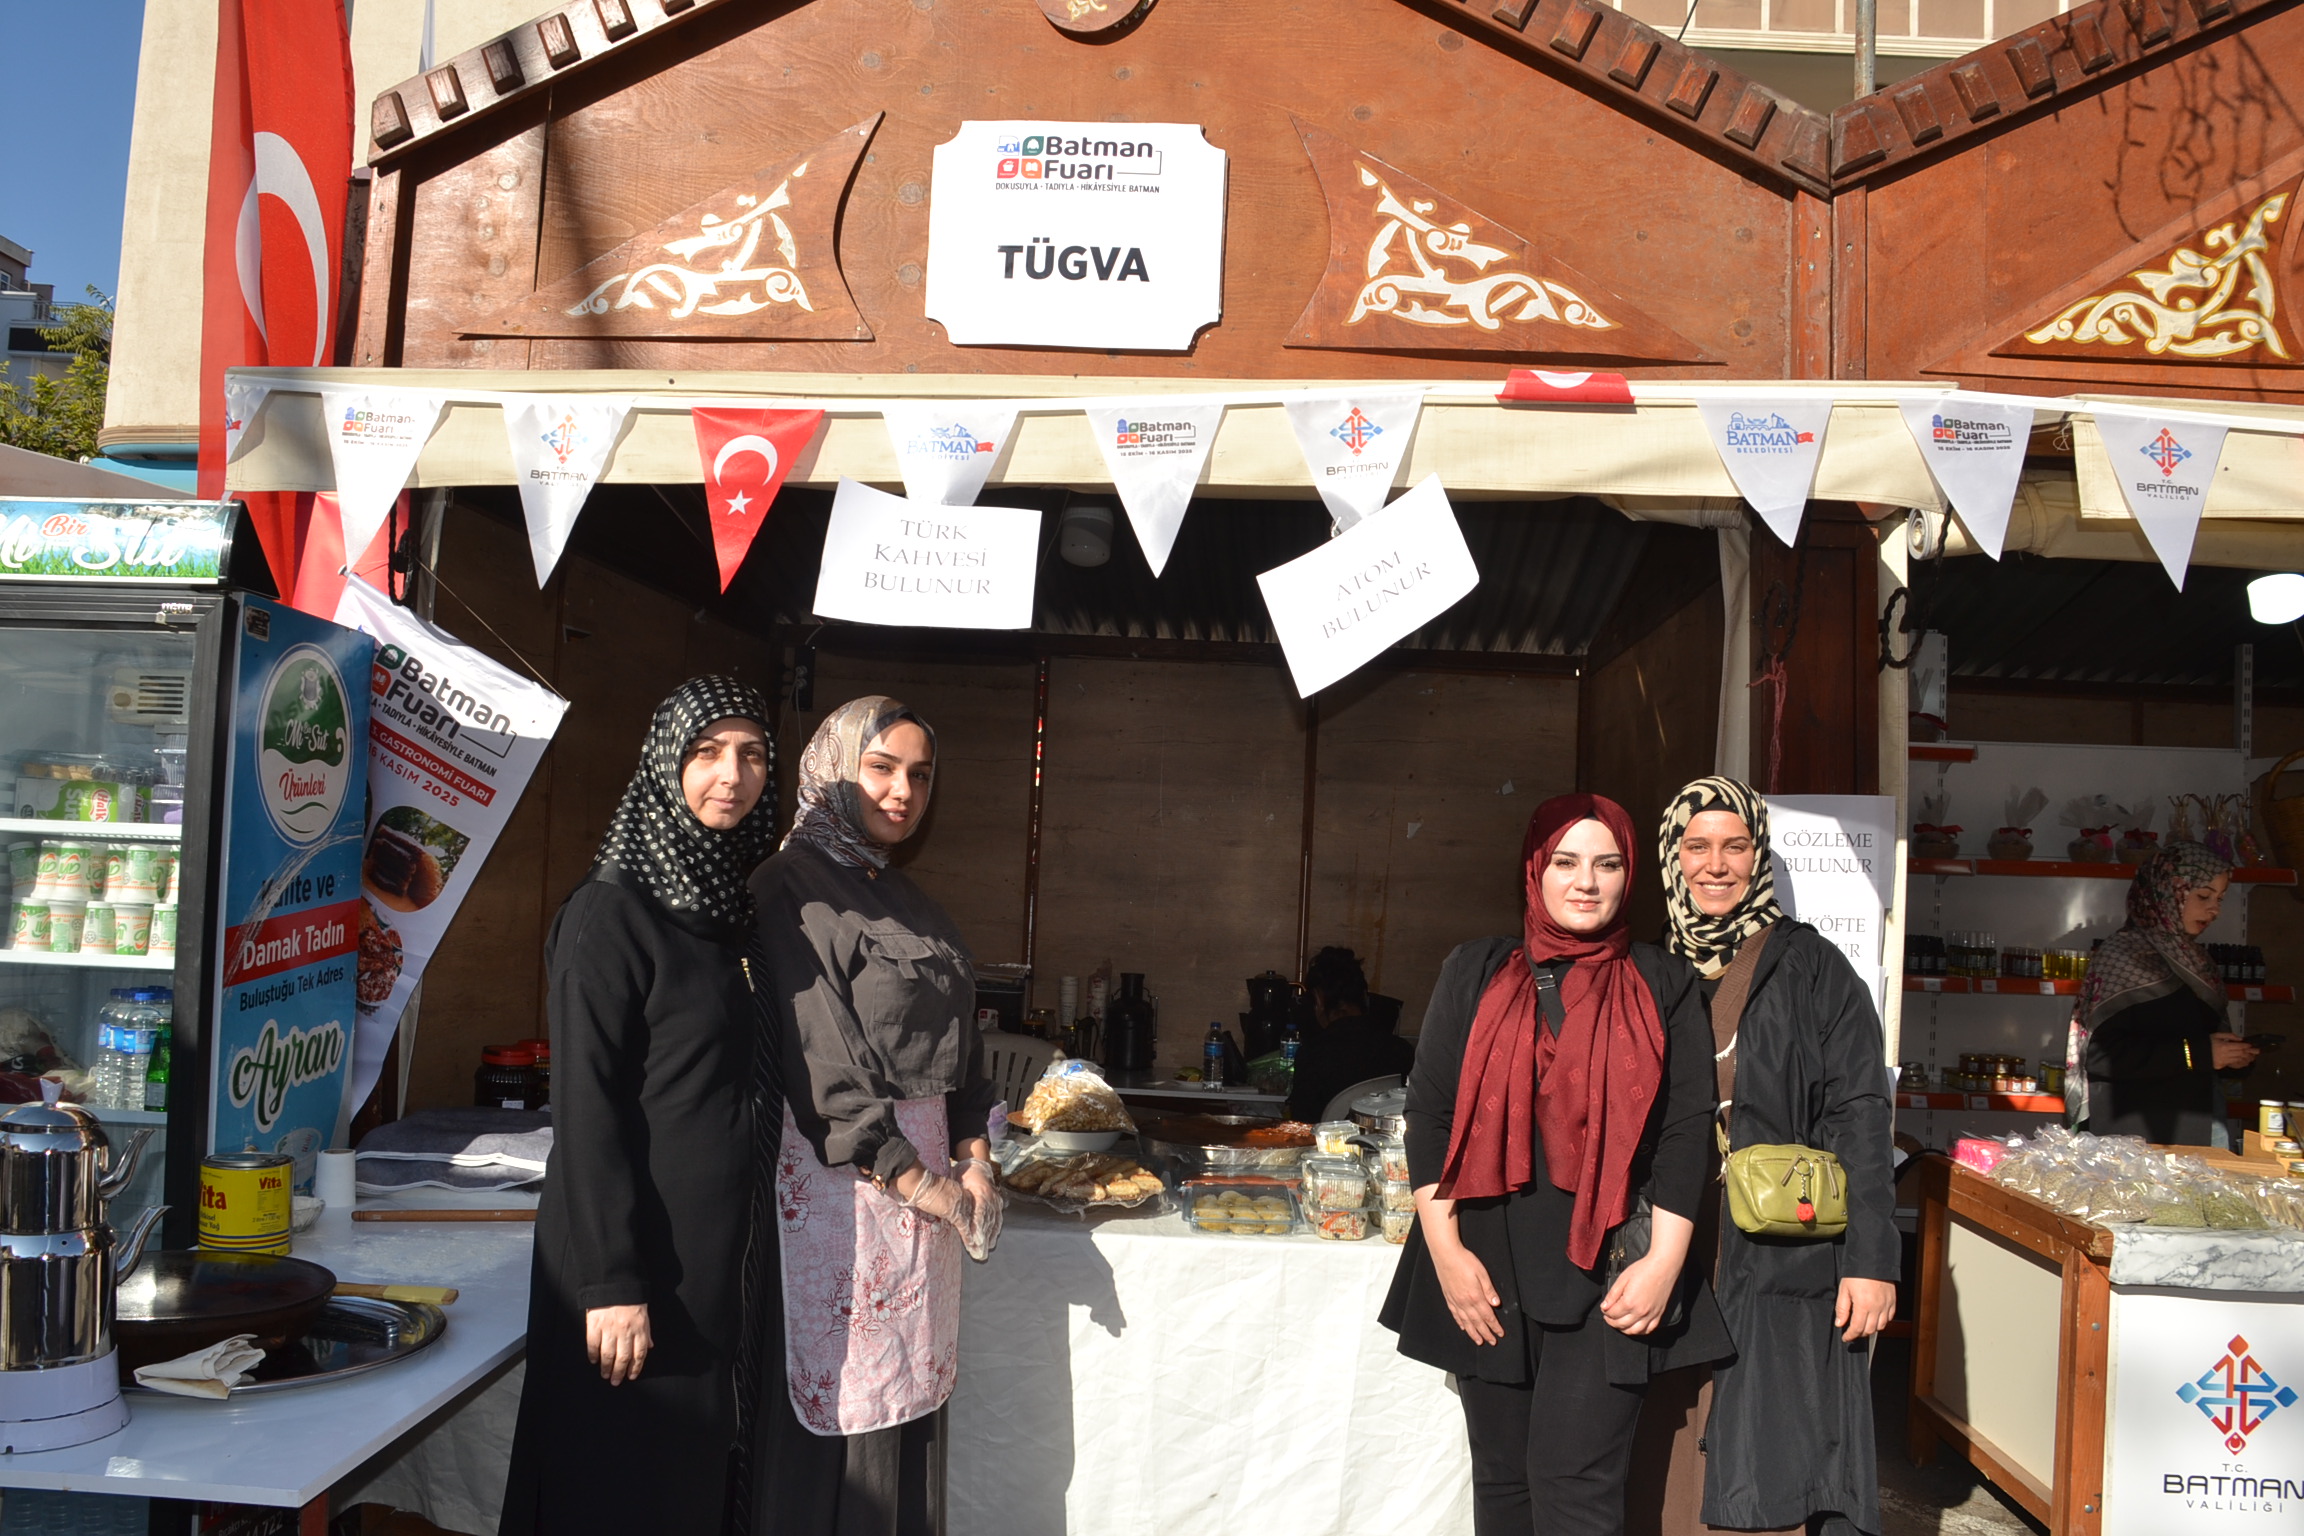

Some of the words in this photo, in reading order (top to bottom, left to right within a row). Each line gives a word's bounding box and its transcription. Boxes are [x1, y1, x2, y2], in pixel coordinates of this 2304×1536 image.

[1045, 136, 1153, 158] Batman
[1044, 159, 1113, 180] Fuarı
[995, 182, 1039, 191] DOKUSUYLA
[1045, 182, 1074, 191] TADIYLA
[1128, 184, 1160, 194] BATMAN
[997, 237, 1150, 282] TÜGVA
[365, 411, 411, 424] Batman
[1139, 422, 1191, 432] Batman
[1954, 419, 2005, 430] Batman
[1139, 433, 1173, 443] Fuarı
[1726, 430, 1799, 446] BATMAN
[1954, 430, 1989, 440] Fuarı
[907, 439, 979, 454] BATMAN
[530, 469, 588, 481] BATMAN
[1326, 462, 1388, 475] BATMAN
[2137, 483, 2198, 495] BATMAN
[43, 514, 88, 537] Bir
[901, 519, 968, 540] TÜRK
[874, 543, 987, 567] KAHVESİ
[864, 571, 990, 595] BULUNUR
[1337, 551, 1401, 601] ATOM
[1322, 561, 1432, 639] BULUNUR
[400, 656, 511, 736] Batman
[386, 679, 461, 739] Fuarı
[382, 703, 412, 728] TADIYLA
[415, 725, 465, 759] HİKÂYESİYLE
[465, 752, 498, 777] BATMAN
[380, 731, 455, 781] GASTRONOMİ
[453, 774, 489, 802] FUARI
[279, 768, 326, 802] Ürünleri
[380, 752, 420, 785] KASIM
[422, 780, 461, 807] 2025
[95, 793, 109, 820] Halk
[1783, 829, 1873, 848] GÖZLEME
[1783, 857, 1873, 874] BULUNUR
[317, 874, 335, 899] ve
[242, 928, 302, 971] Damak
[305, 920, 345, 953] Tadın
[239, 979, 295, 1012] Buluştuğu
[297, 972, 315, 993] Tek
[316, 966, 344, 989] Adres
[232, 1026, 343, 1126] Ayran
[259, 1176, 282, 1190] Vita
[200, 1180, 228, 1211] ita
[2222, 1463, 2248, 1473] T.C.
[2163, 1474, 2304, 1500] BATMAN
[2186, 1500, 2283, 1513] VALİLİĞİ
